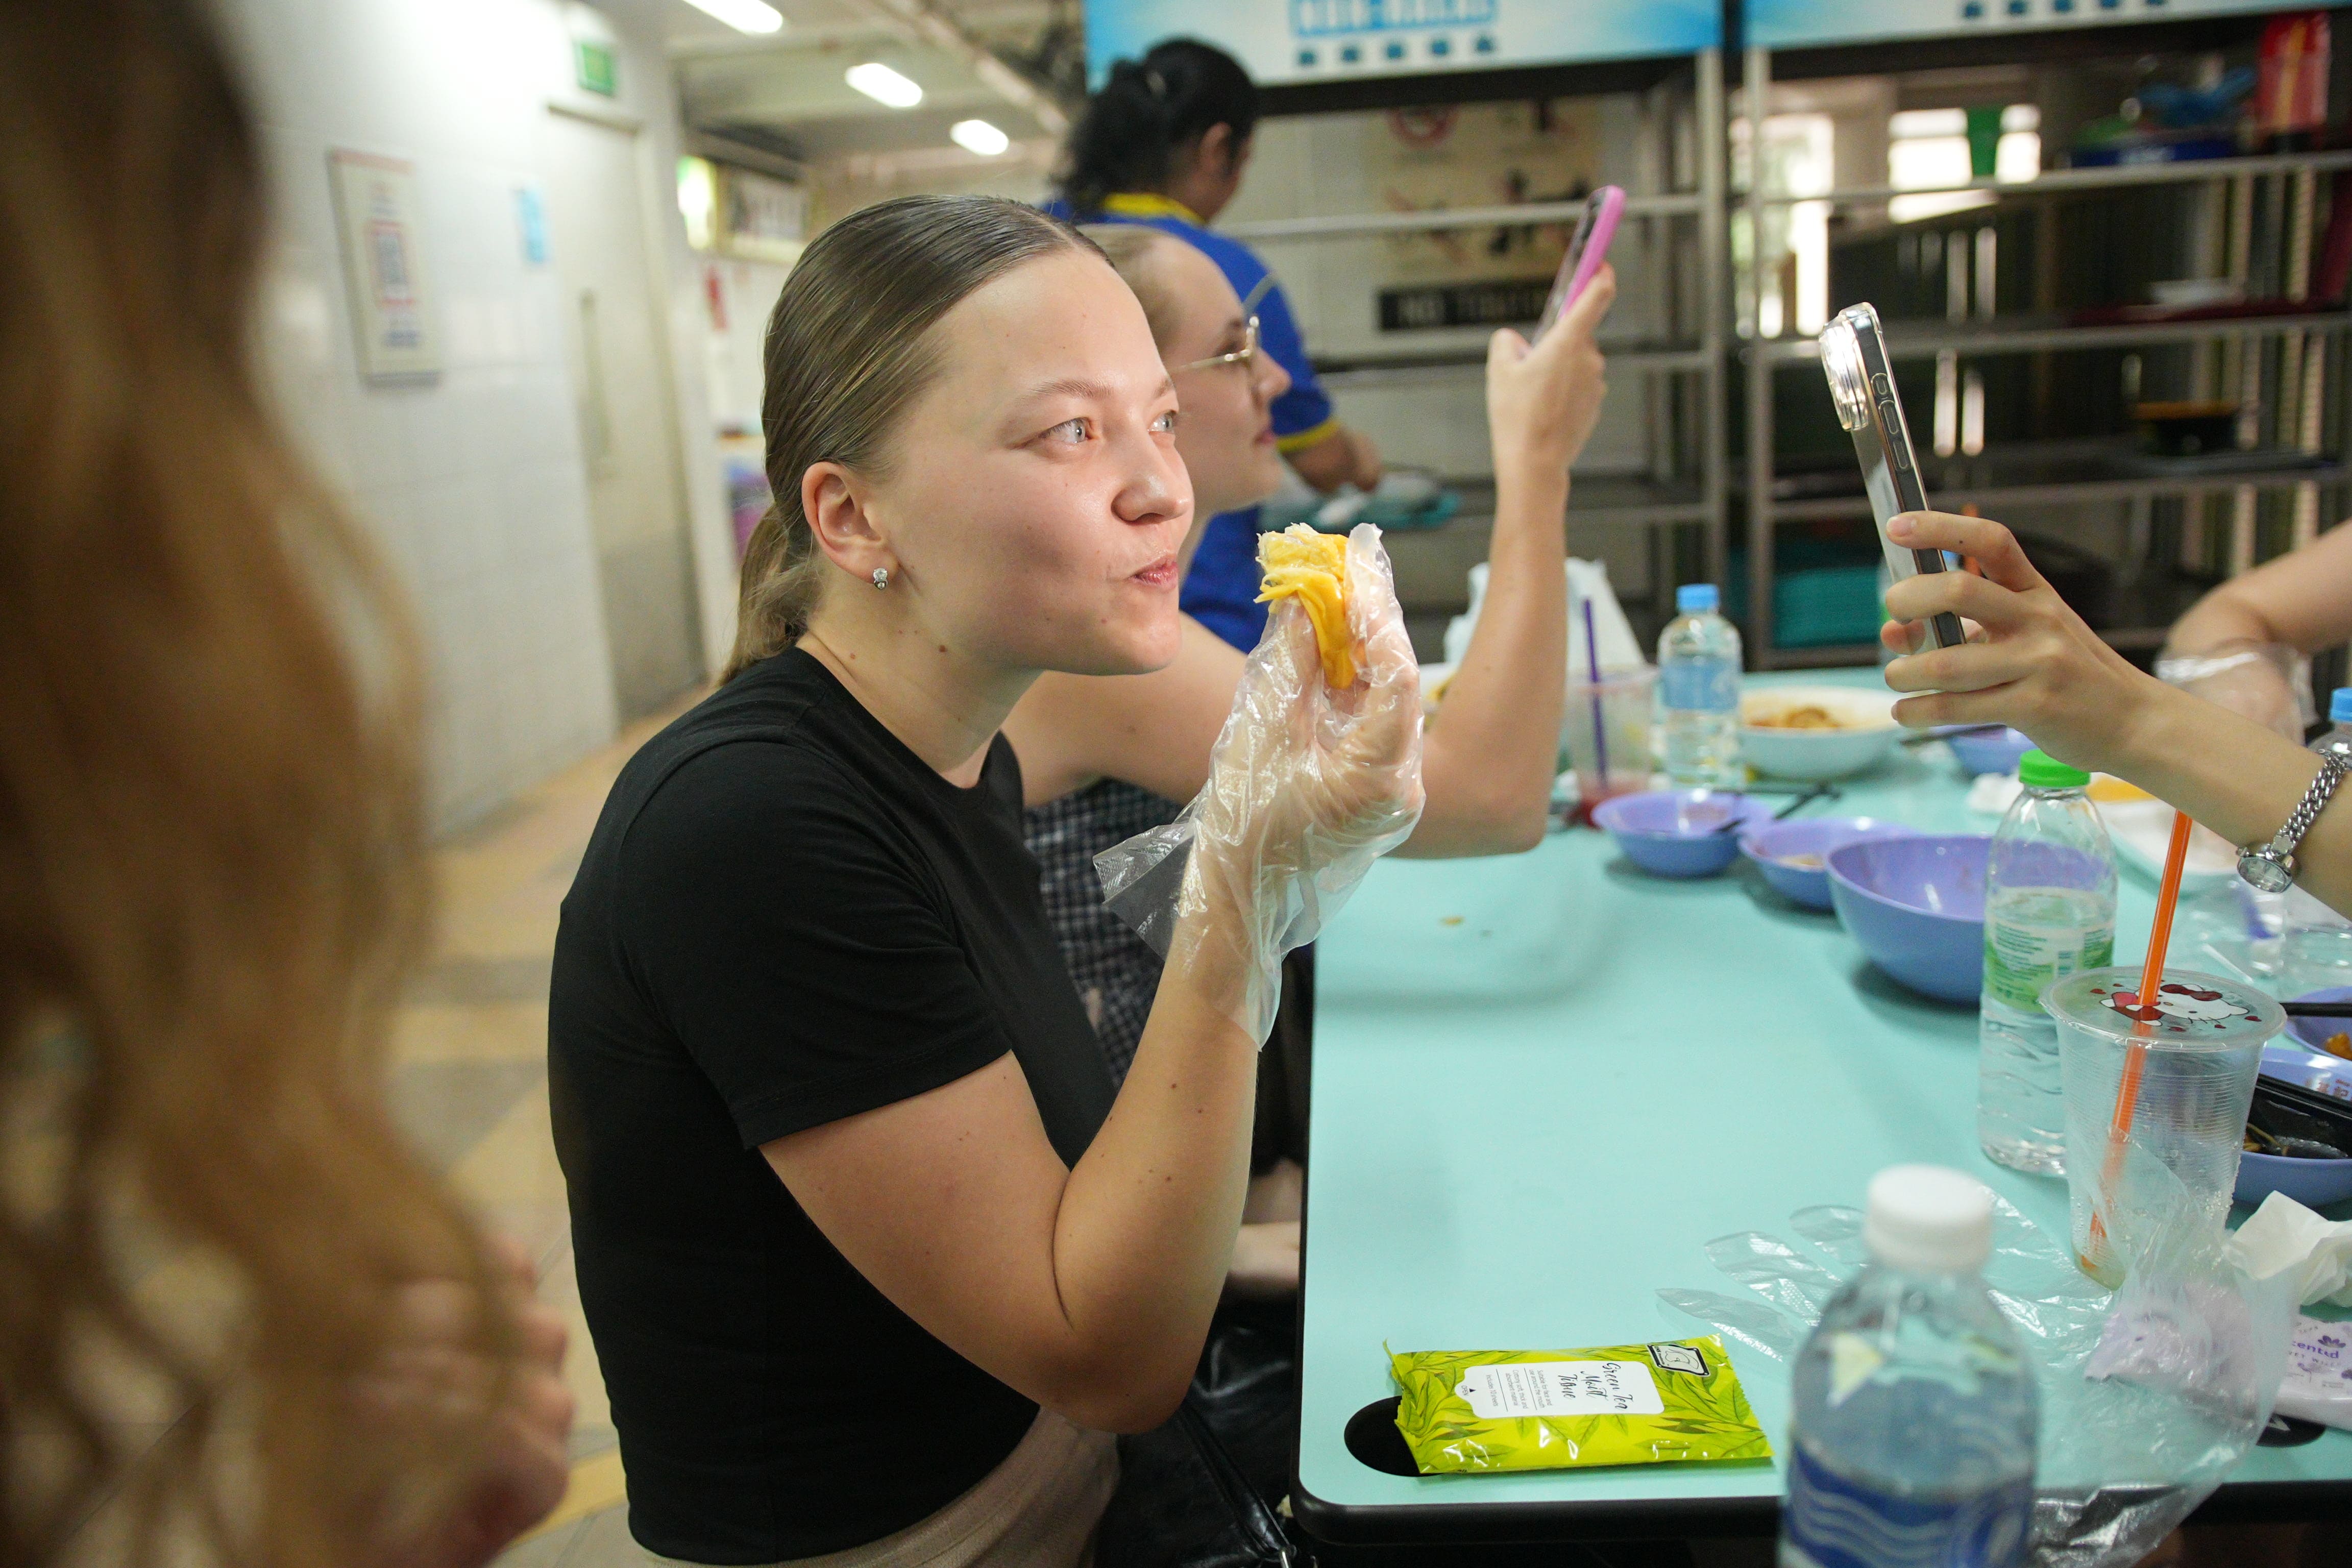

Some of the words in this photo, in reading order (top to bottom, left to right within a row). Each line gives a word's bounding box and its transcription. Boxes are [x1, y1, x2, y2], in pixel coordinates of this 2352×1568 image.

[1486, 1375, 1494, 1389] Includes
[1506, 1373, 1515, 1391] absorbent
[1512, 1369, 1521, 1383] Cottony
[1537, 1370, 1546, 1384] Suitable
[1558, 1374, 1578, 1400] Tissue
[1580, 1371, 1609, 1401] Moist
[1602, 1363, 1621, 1390] Green
[1613, 1394, 1633, 1410] Tea
[1510, 1391, 1518, 1406] material
[1537, 1395, 1546, 1408] mouth
